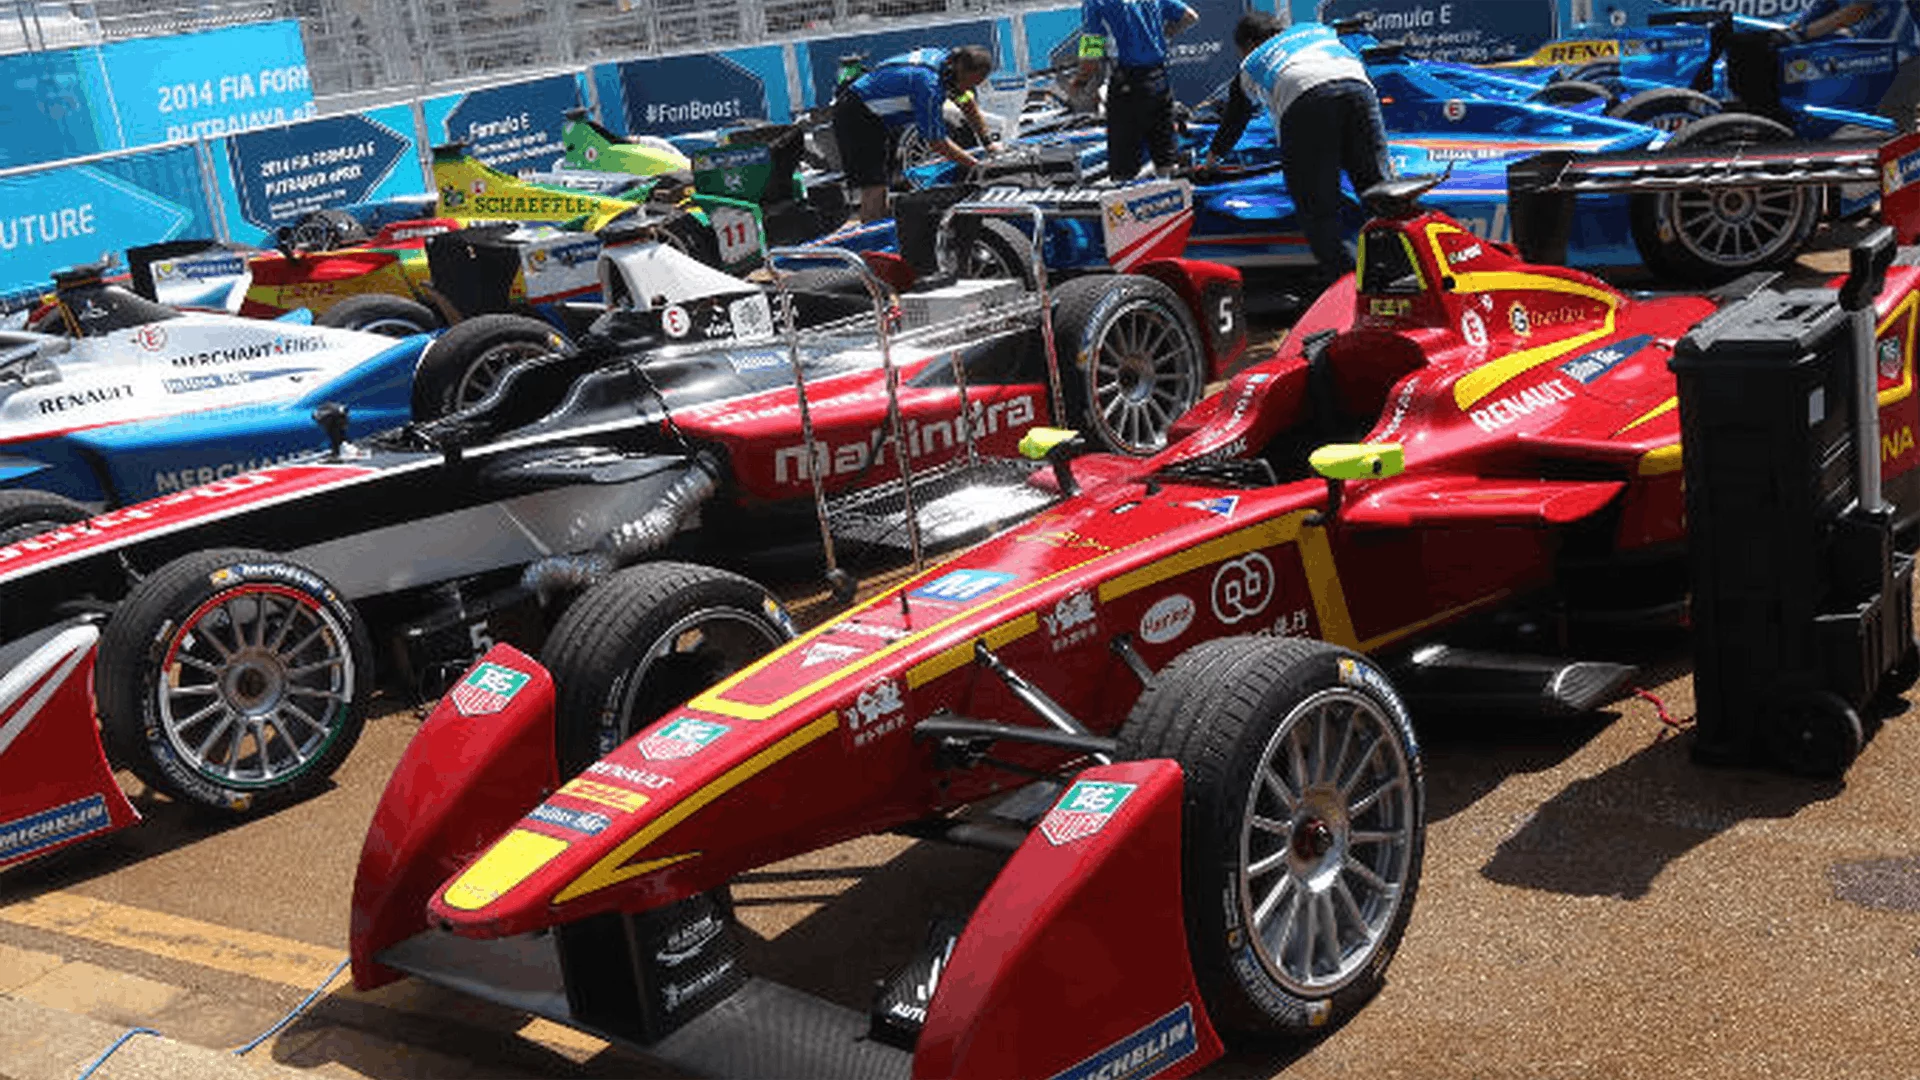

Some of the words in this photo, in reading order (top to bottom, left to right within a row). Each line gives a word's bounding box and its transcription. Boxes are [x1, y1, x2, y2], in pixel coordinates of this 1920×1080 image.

[157, 80, 213, 113] 2014
[219, 73, 256, 103] FIA
[646, 99, 741, 123] #FanBoost
[474, 196, 600, 214] SCHAEFFLER
[721, 221, 748, 248] 11
[1219, 295, 1233, 335] 5
[38, 384, 134, 414] RENAULT
[1469, 378, 1576, 434] RENAULT
